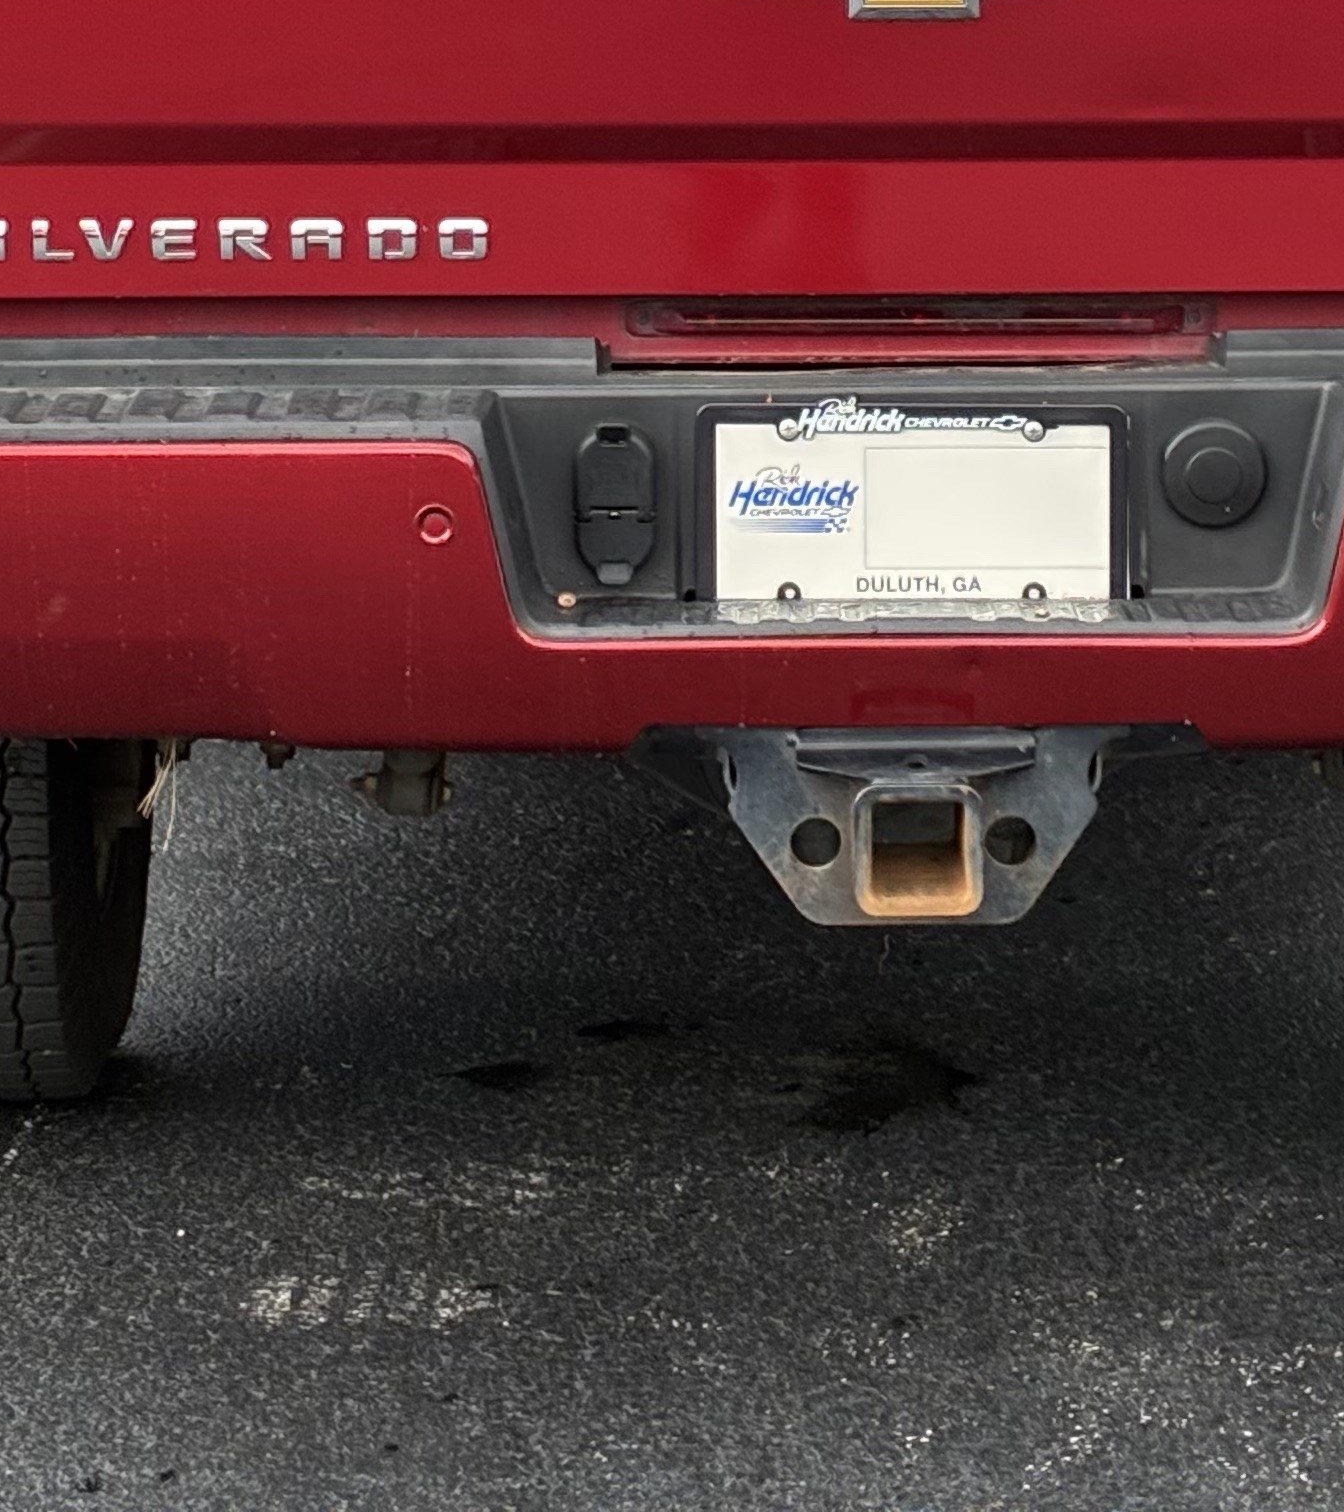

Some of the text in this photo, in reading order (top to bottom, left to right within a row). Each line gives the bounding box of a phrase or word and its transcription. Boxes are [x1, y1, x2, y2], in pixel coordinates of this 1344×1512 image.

[798, 407, 991, 439] Hendrick CHEVROLET
[728, 480, 859, 516] Hendrick
[749, 507, 821, 517] CHEVROLET
[856, 575, 982, 595] DULUTH, GA
